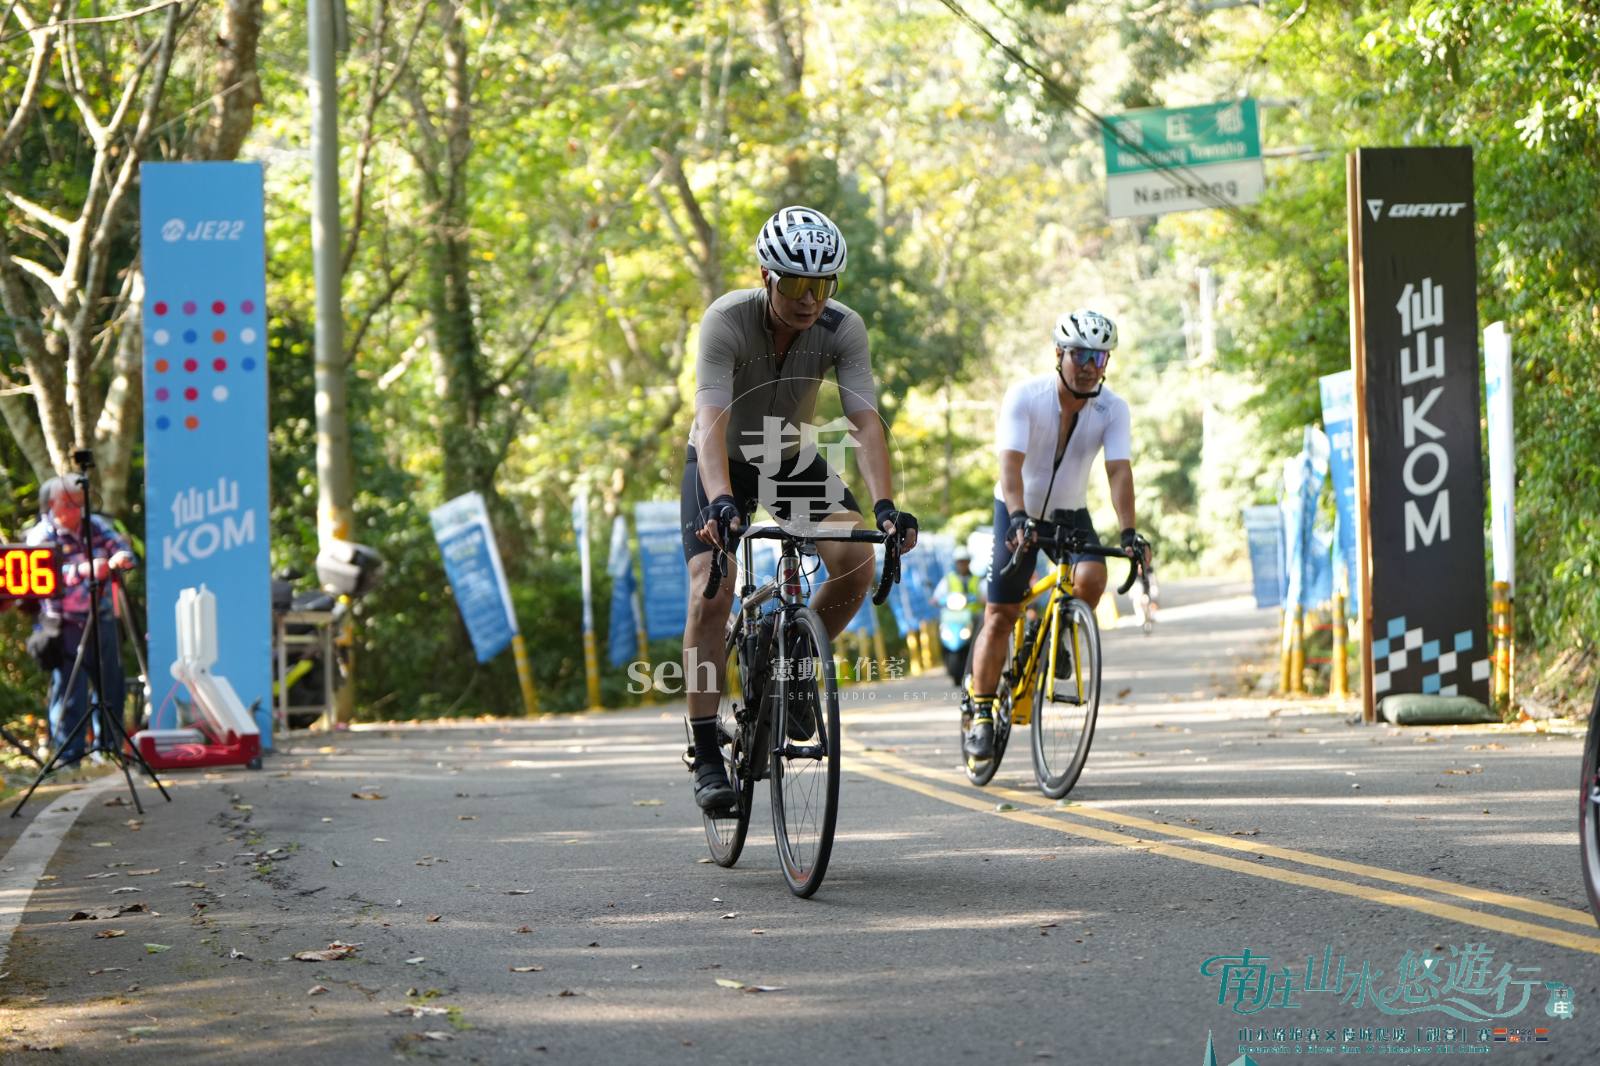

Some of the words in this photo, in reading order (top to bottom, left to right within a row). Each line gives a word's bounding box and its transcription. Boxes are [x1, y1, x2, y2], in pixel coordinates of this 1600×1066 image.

[1388, 202, 1467, 218] GIANT
[187, 219, 244, 241] JE22
[170, 477, 239, 530] 仙山
[163, 508, 255, 570] KOM
